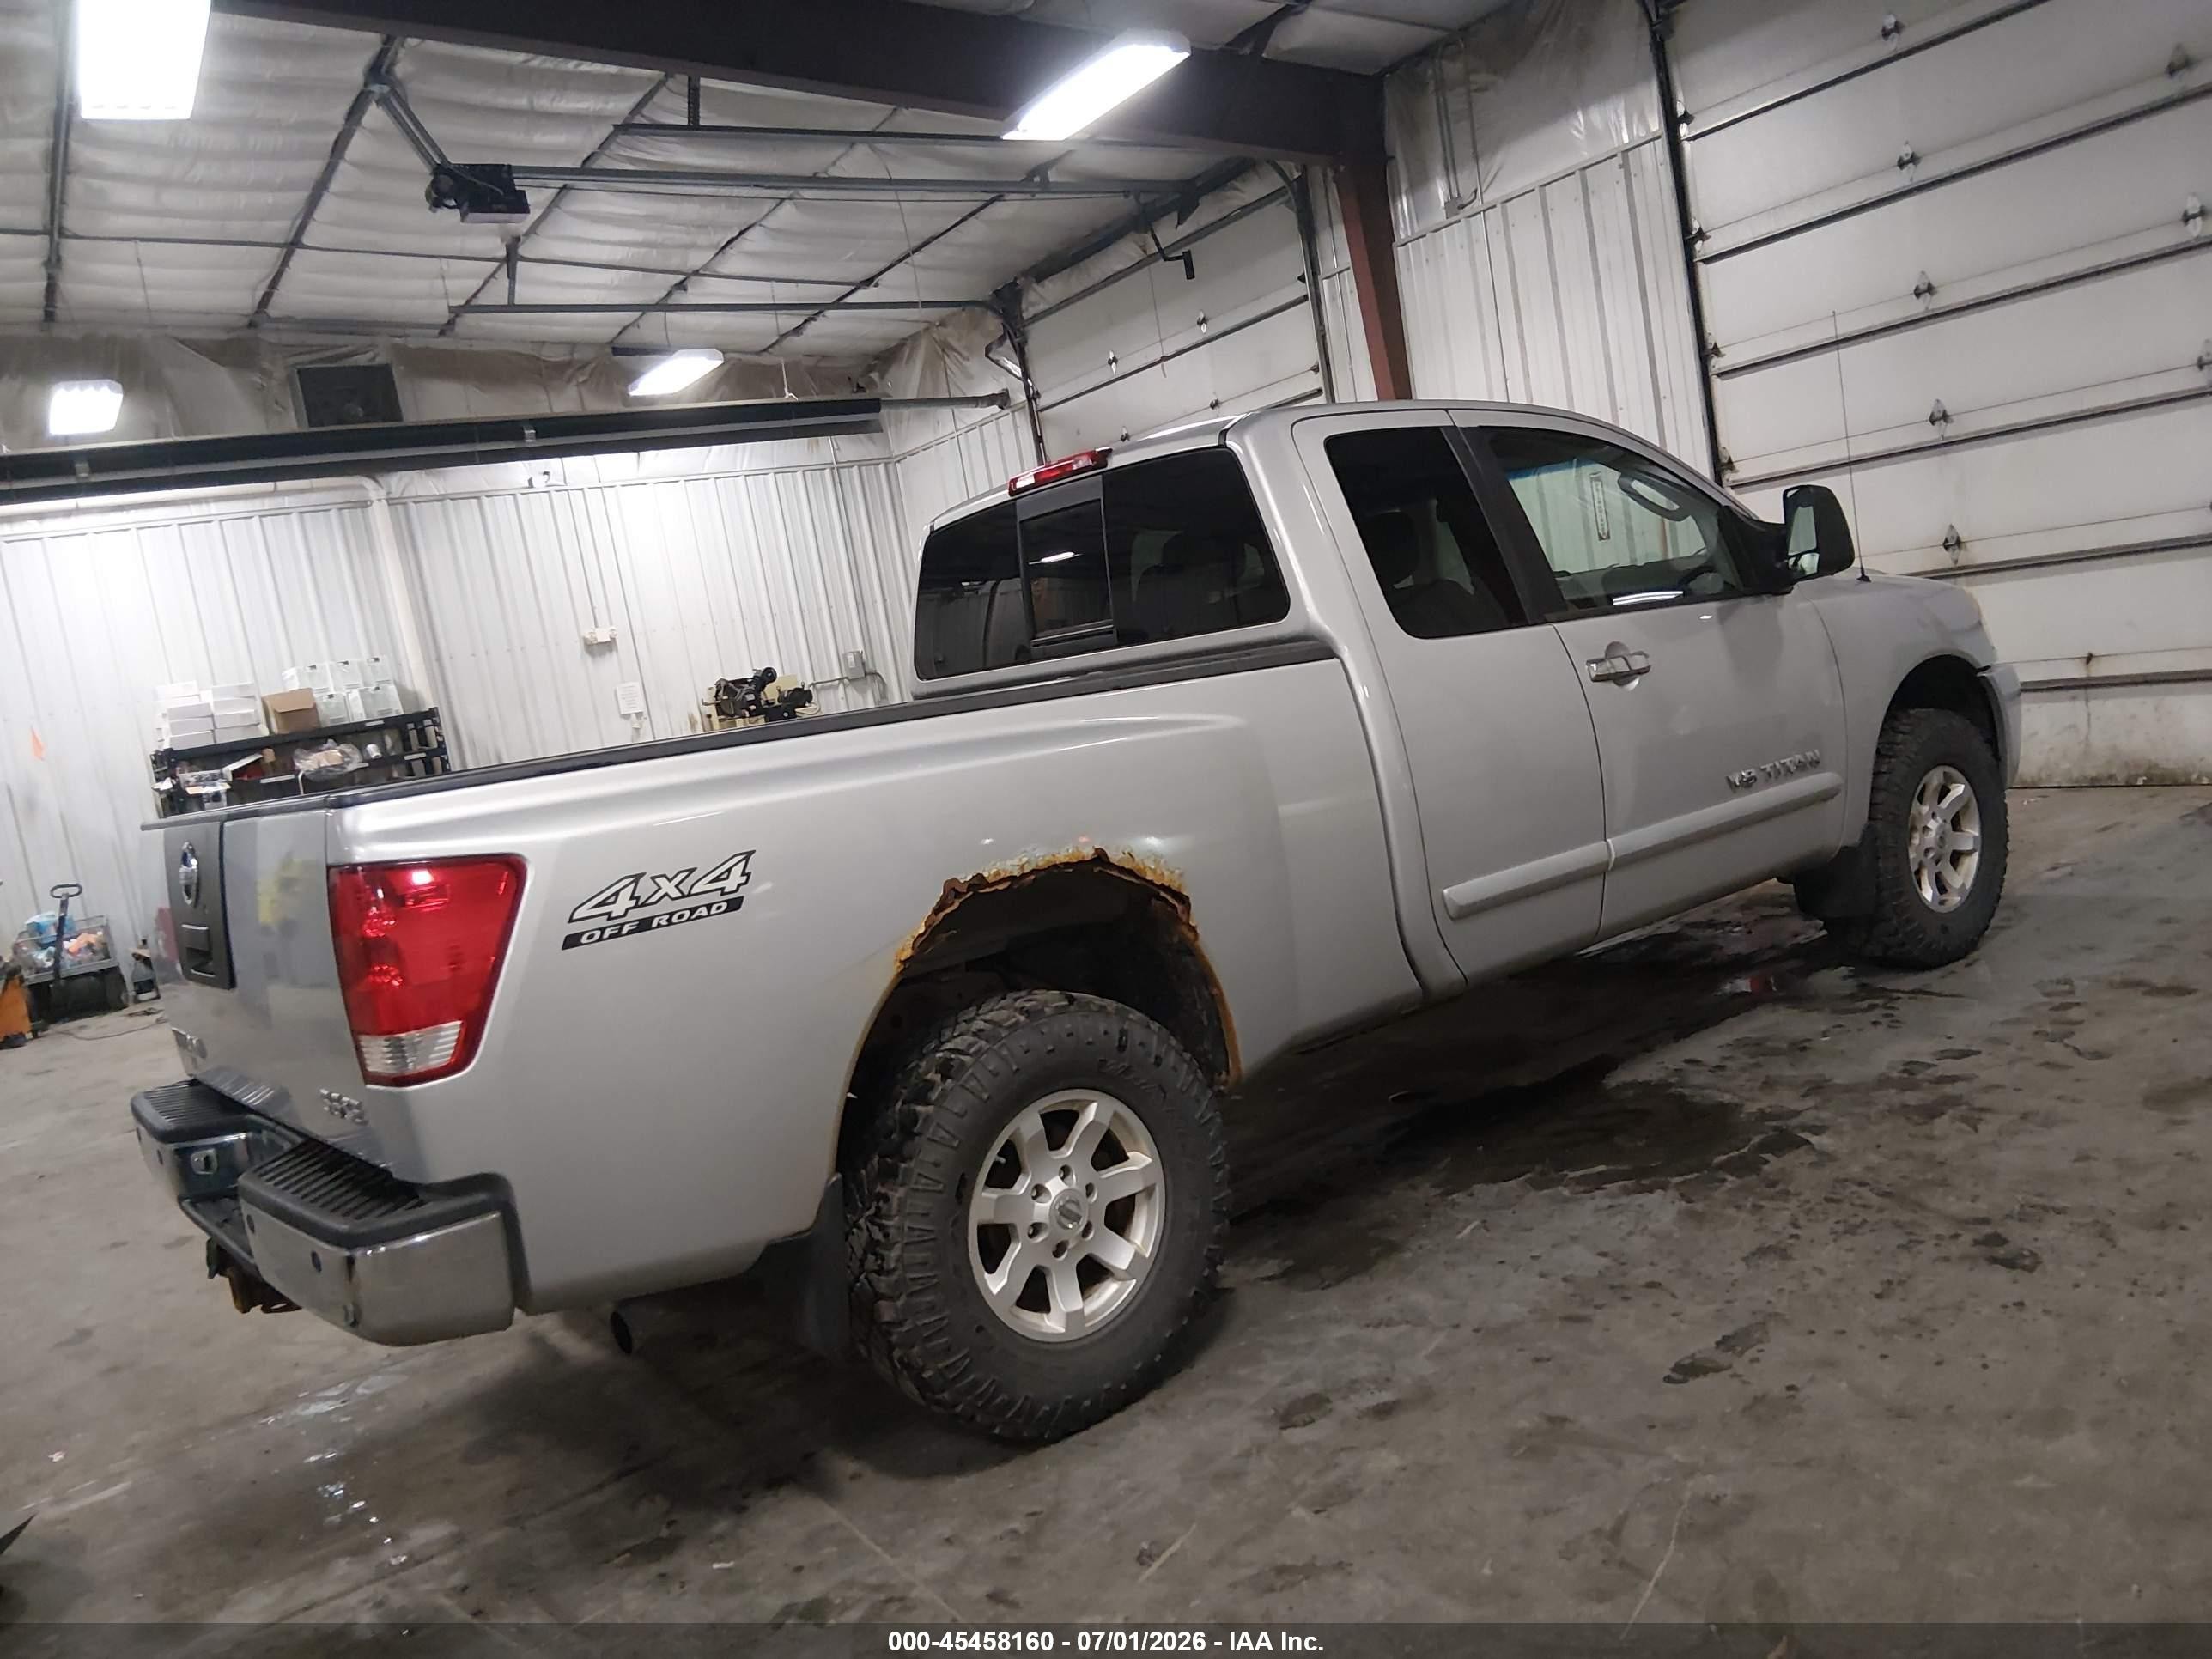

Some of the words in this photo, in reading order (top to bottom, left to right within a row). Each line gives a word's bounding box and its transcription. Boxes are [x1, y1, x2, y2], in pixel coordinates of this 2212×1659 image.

[1759, 750, 1821, 779] TITAN
[580, 921, 640, 945] OFF
[651, 902, 729, 927] ROAD
